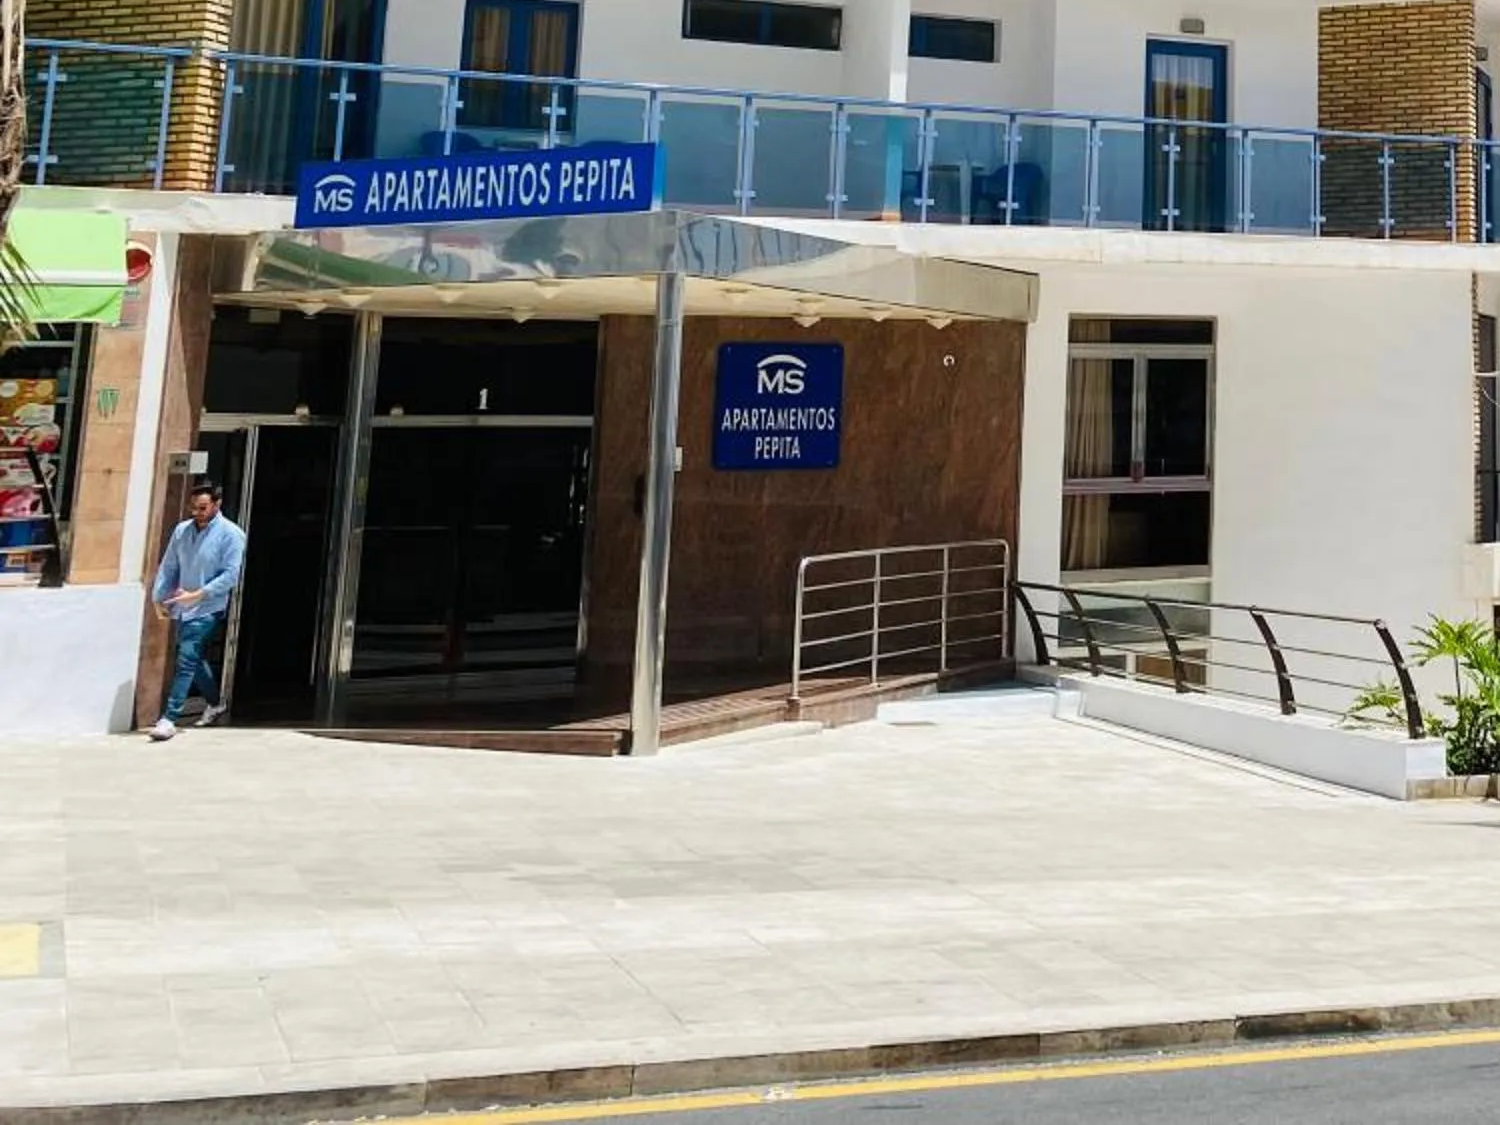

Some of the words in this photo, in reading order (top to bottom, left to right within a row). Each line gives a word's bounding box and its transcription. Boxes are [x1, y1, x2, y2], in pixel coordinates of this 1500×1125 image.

[364, 162, 550, 213] APARTAMENTOS
[559, 156, 635, 203] PEPITA
[312, 188, 353, 214] MS
[757, 368, 805, 394] MS
[479, 388, 488, 410] 1
[721, 407, 836, 432] APARTAMENTOS
[754, 435, 801, 460] PEPITA
